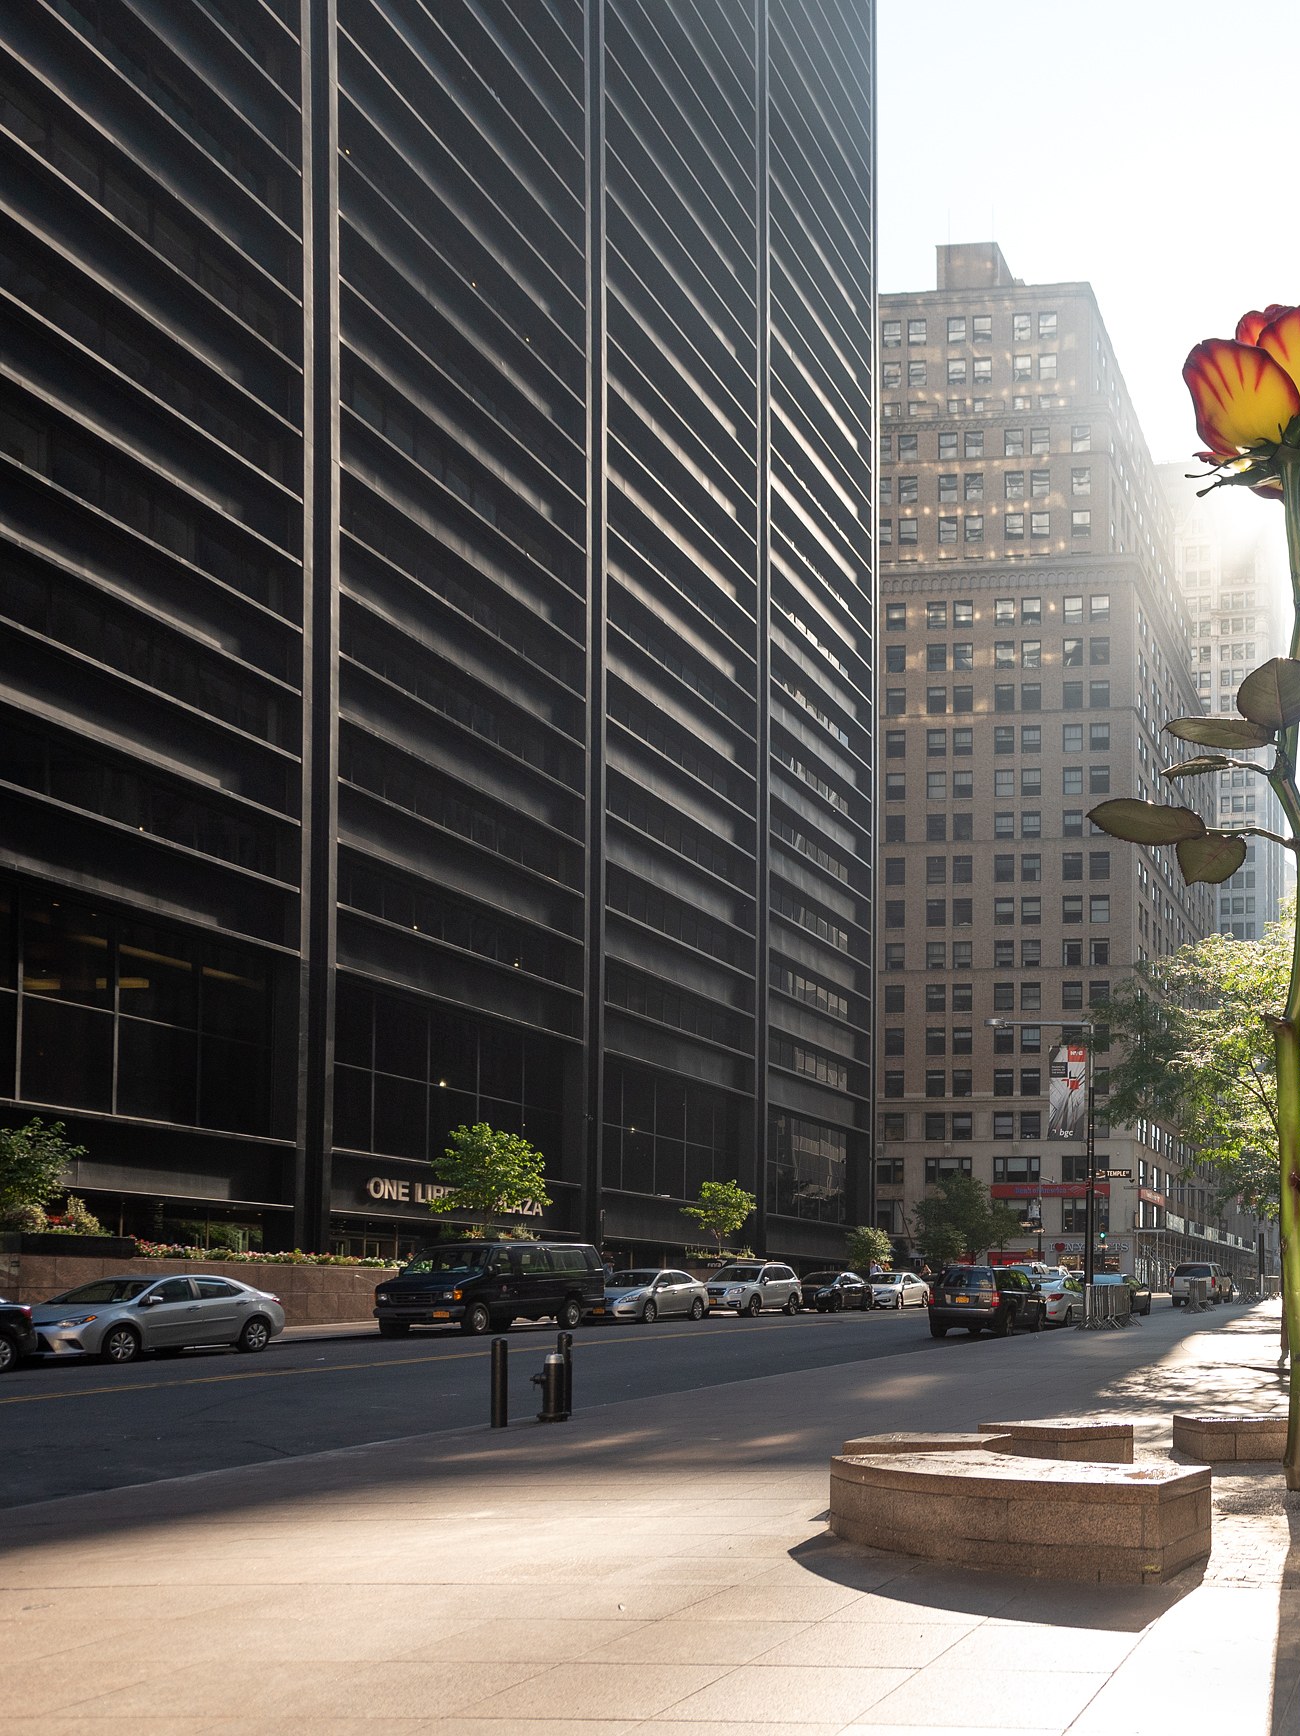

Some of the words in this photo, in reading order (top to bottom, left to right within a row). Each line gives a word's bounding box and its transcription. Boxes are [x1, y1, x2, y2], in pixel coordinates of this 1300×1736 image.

[1059, 1129, 1074, 1139] bgc
[367, 1176, 410, 1202] ONE
[1065, 1243, 1084, 1252] NY
